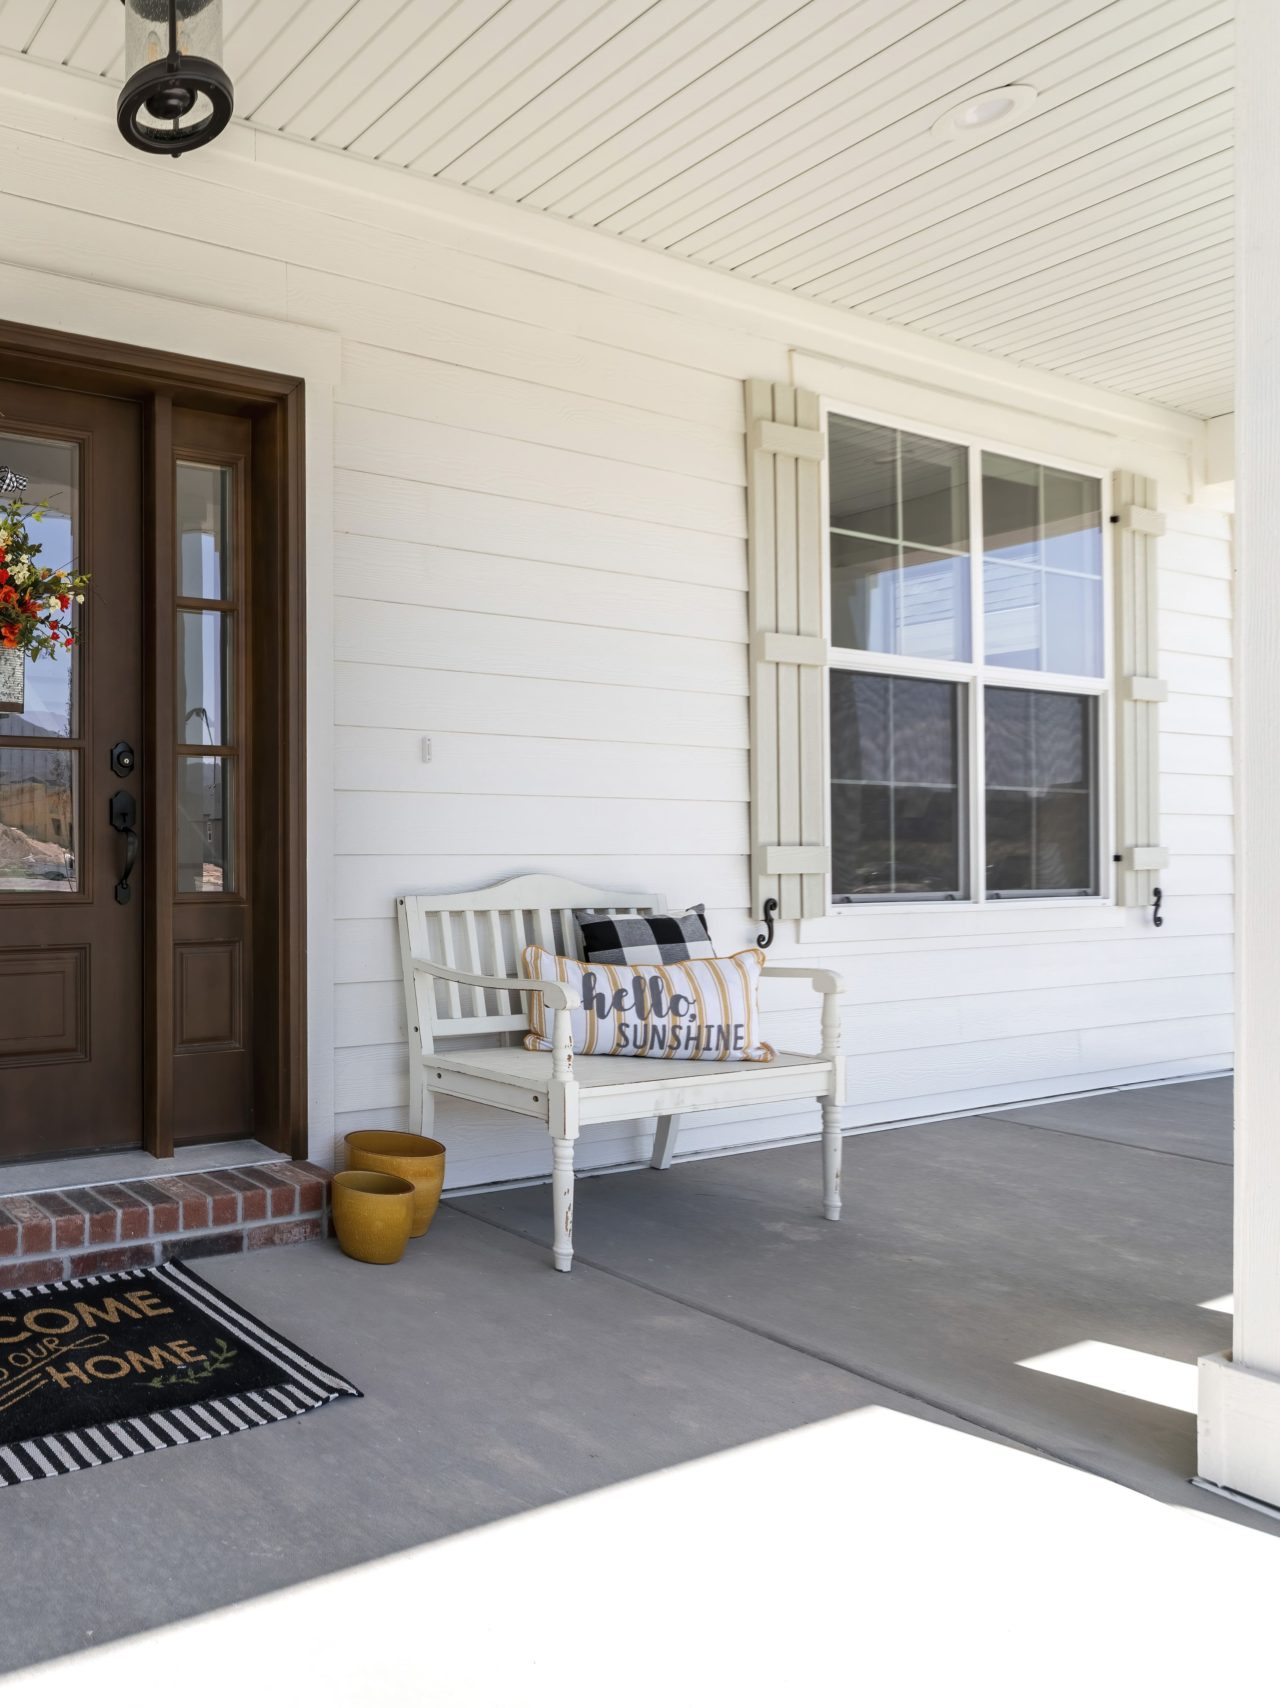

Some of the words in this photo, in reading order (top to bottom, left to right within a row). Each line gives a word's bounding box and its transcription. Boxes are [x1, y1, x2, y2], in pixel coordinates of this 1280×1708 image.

[617, 1022, 745, 1052] SUNSHINE
[8, 1336, 67, 1367] OUR
[45, 1340, 208, 1389] HOME
